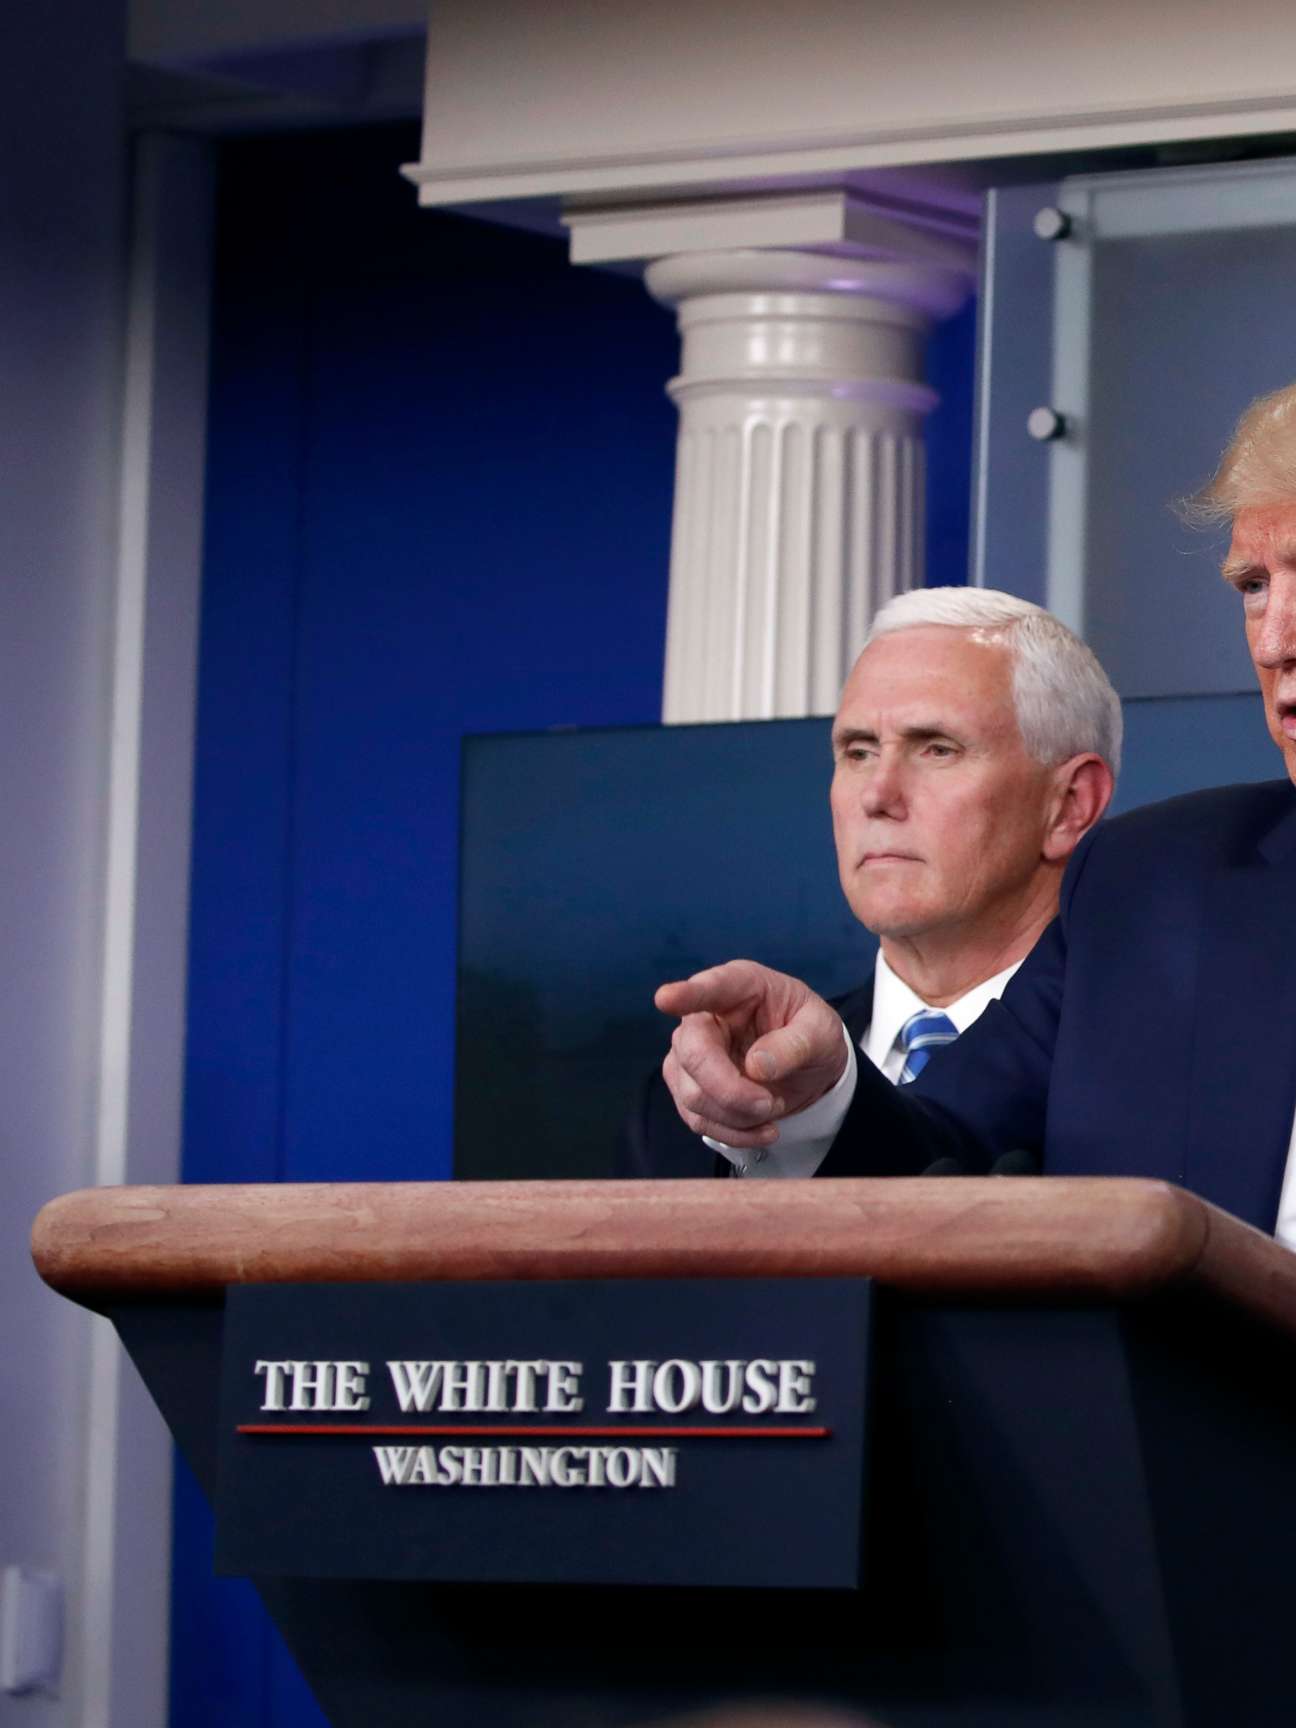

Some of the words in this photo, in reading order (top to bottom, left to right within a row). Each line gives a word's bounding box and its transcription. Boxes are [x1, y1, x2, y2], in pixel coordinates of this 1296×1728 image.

[255, 1360, 370, 1411] THE
[387, 1359, 583, 1413] WHITE
[607, 1359, 816, 1415] HOUSE
[373, 1446, 677, 1488] WASHINGTON
